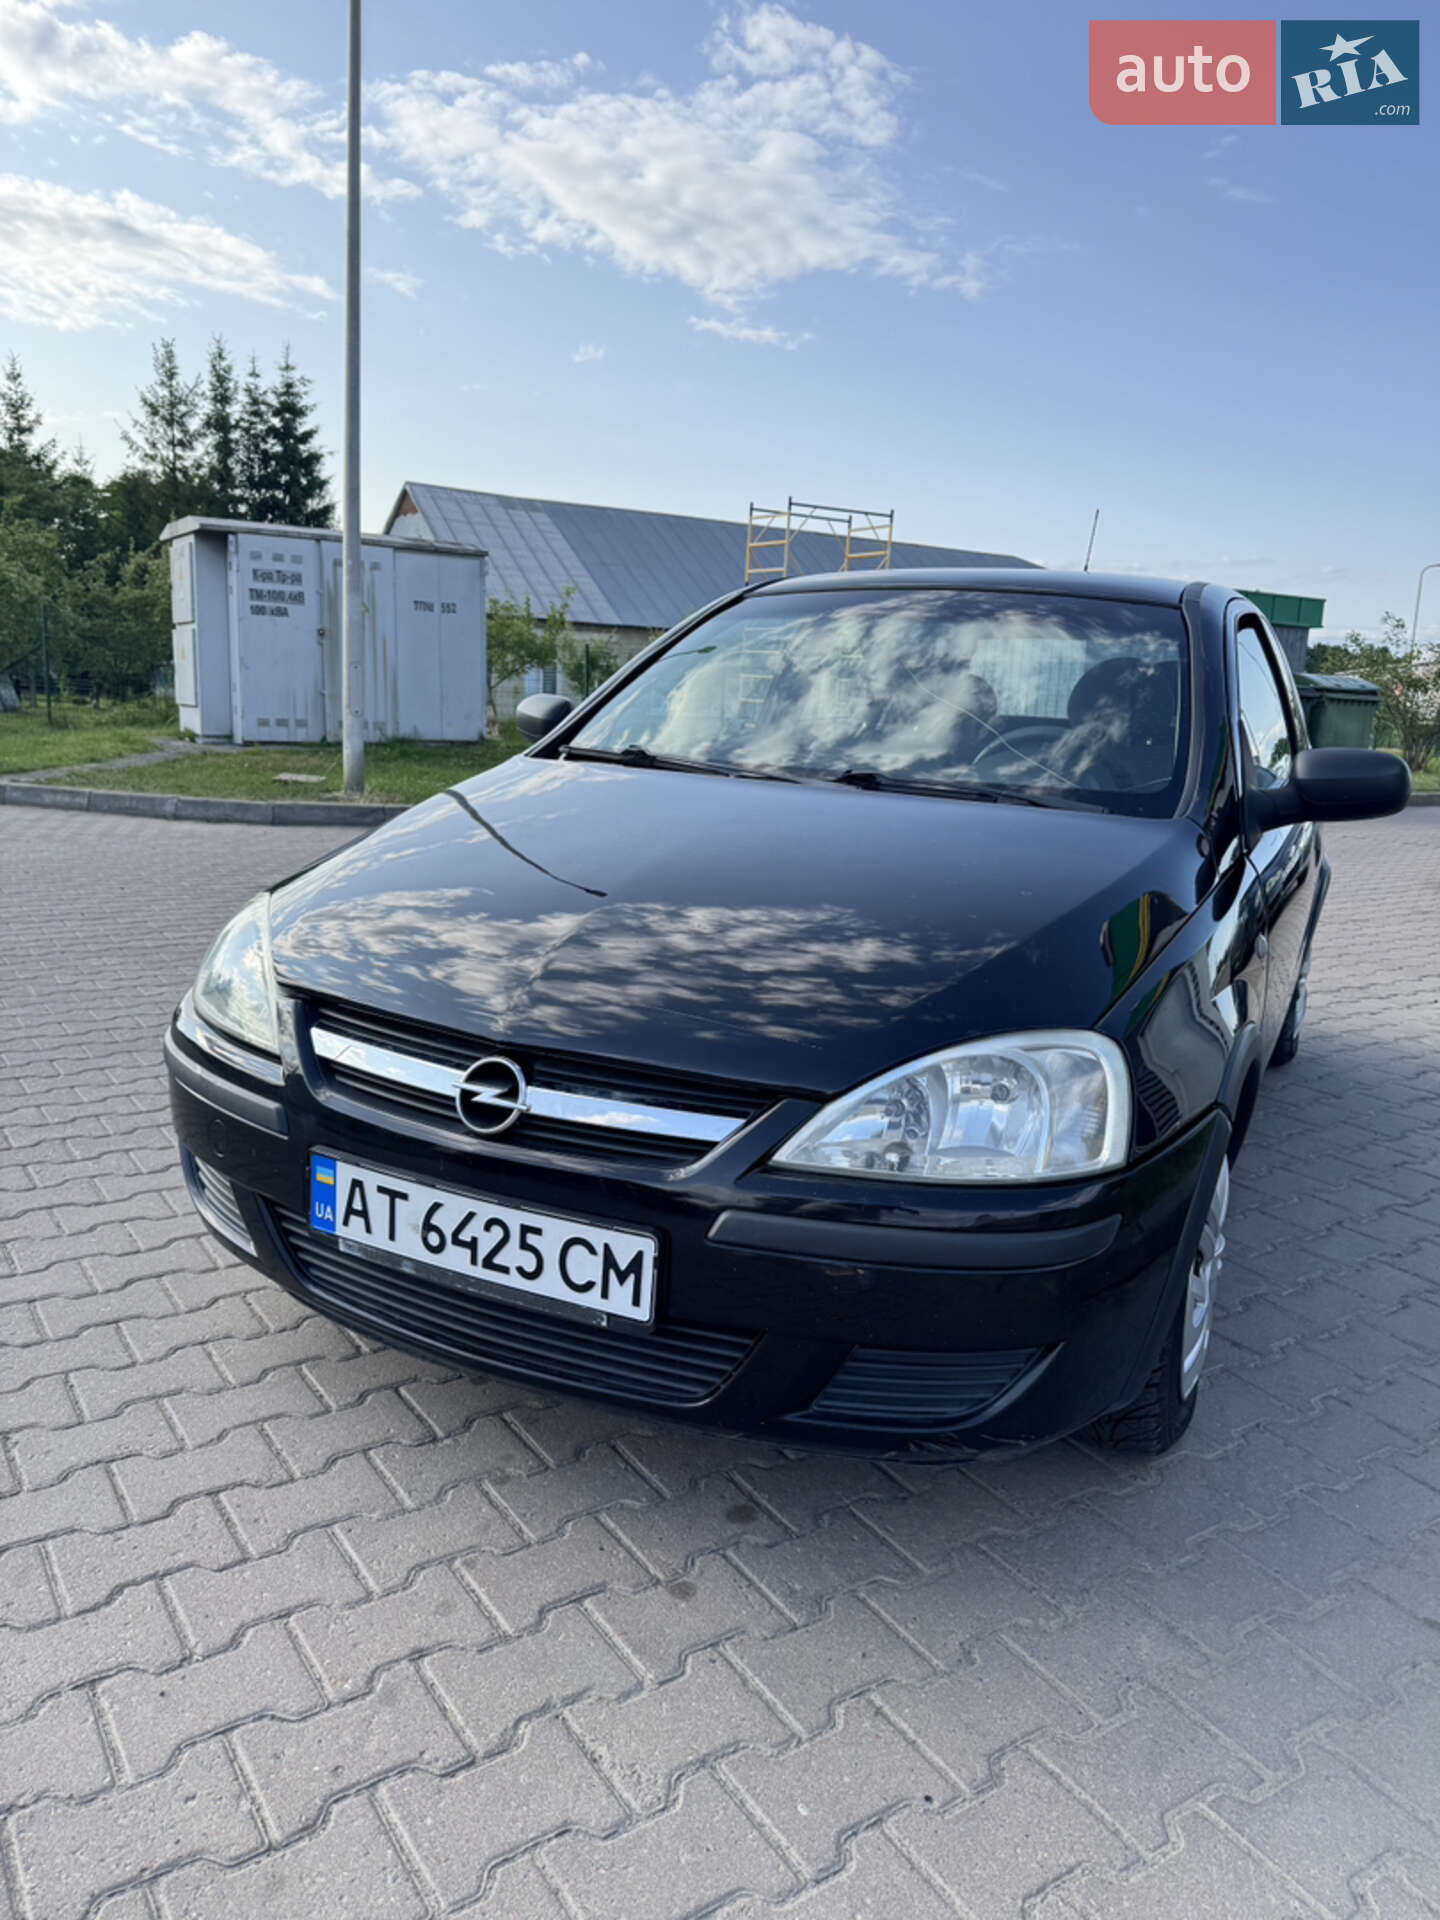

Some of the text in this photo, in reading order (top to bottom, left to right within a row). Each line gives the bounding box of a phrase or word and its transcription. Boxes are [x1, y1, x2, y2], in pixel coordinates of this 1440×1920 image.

[314, 1200, 335, 1222] UA
[342, 1177, 645, 1308] AT 6425 CM
